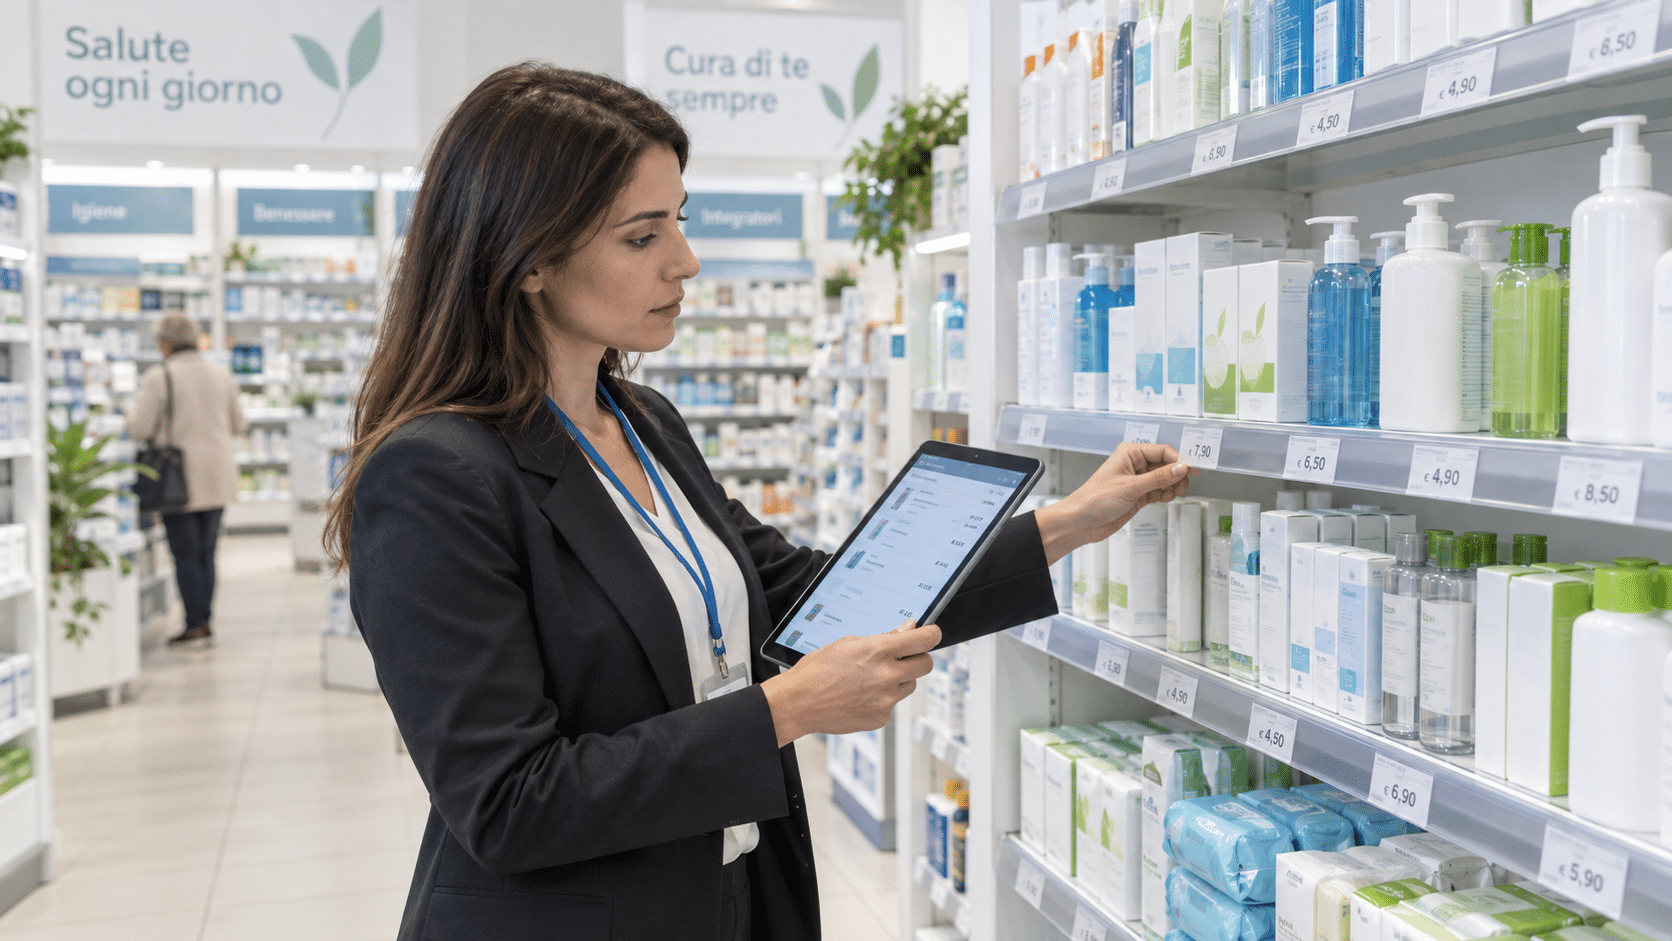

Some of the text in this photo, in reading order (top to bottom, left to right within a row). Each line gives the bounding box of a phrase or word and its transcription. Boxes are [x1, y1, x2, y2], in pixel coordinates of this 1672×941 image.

[65, 25, 190, 64] Salute
[664, 45, 809, 79] Cura di te
[65, 69, 283, 111] ogni giorno
[1448, 75, 1477, 97] 4,90
[665, 89, 778, 119] sempre
[1316, 113, 1340, 133] 4,50
[1208, 144, 1226, 161] 6,90
[72, 200, 128, 224] Igiene
[253, 203, 334, 222] Benessere
[701, 208, 782, 229] Integratori
[1194, 444, 1211, 460] 7,90
[1304, 455, 1326, 471] 6,50
[1432, 468, 1460, 487] 4,90
[1584, 484, 1619, 505] 8,50
[1391, 784, 1416, 807] 6,90
[1569, 862, 1604, 892] 5,90
